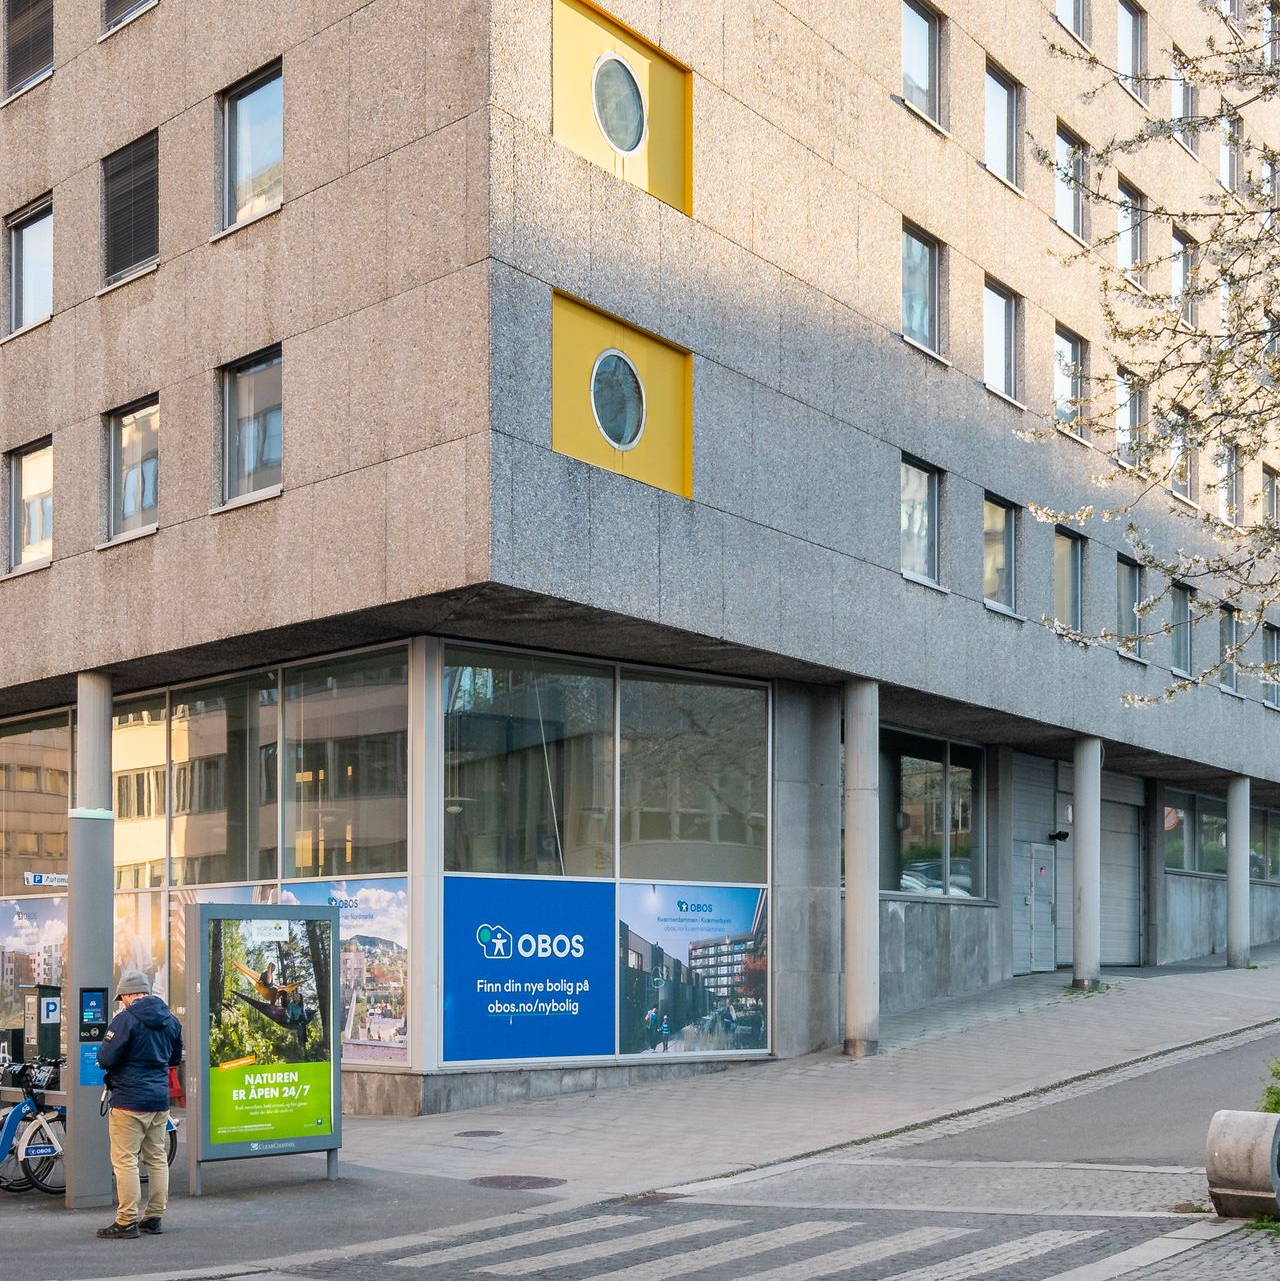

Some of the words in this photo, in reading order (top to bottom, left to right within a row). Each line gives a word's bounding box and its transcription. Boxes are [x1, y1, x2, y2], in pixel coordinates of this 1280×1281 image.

[339, 899, 358, 908] OBOS
[690, 903, 713, 913] OBOS
[517, 934, 585, 958] OBOS
[477, 979, 502, 993] Finn
[504, 979, 521, 992] din
[524, 981, 544, 996] nye
[546, 979, 573, 995] bolig
[576, 979, 590, 995] på
[46, 1002, 57, 1019] P
[488, 999, 579, 1015] obos.no/nybolig
[245, 1071, 298, 1085] NATUREN
[232, 1089, 246, 1101] ER
[249, 1085, 279, 1100] ÅPEN
[282, 1085, 310, 1099] 24/7
